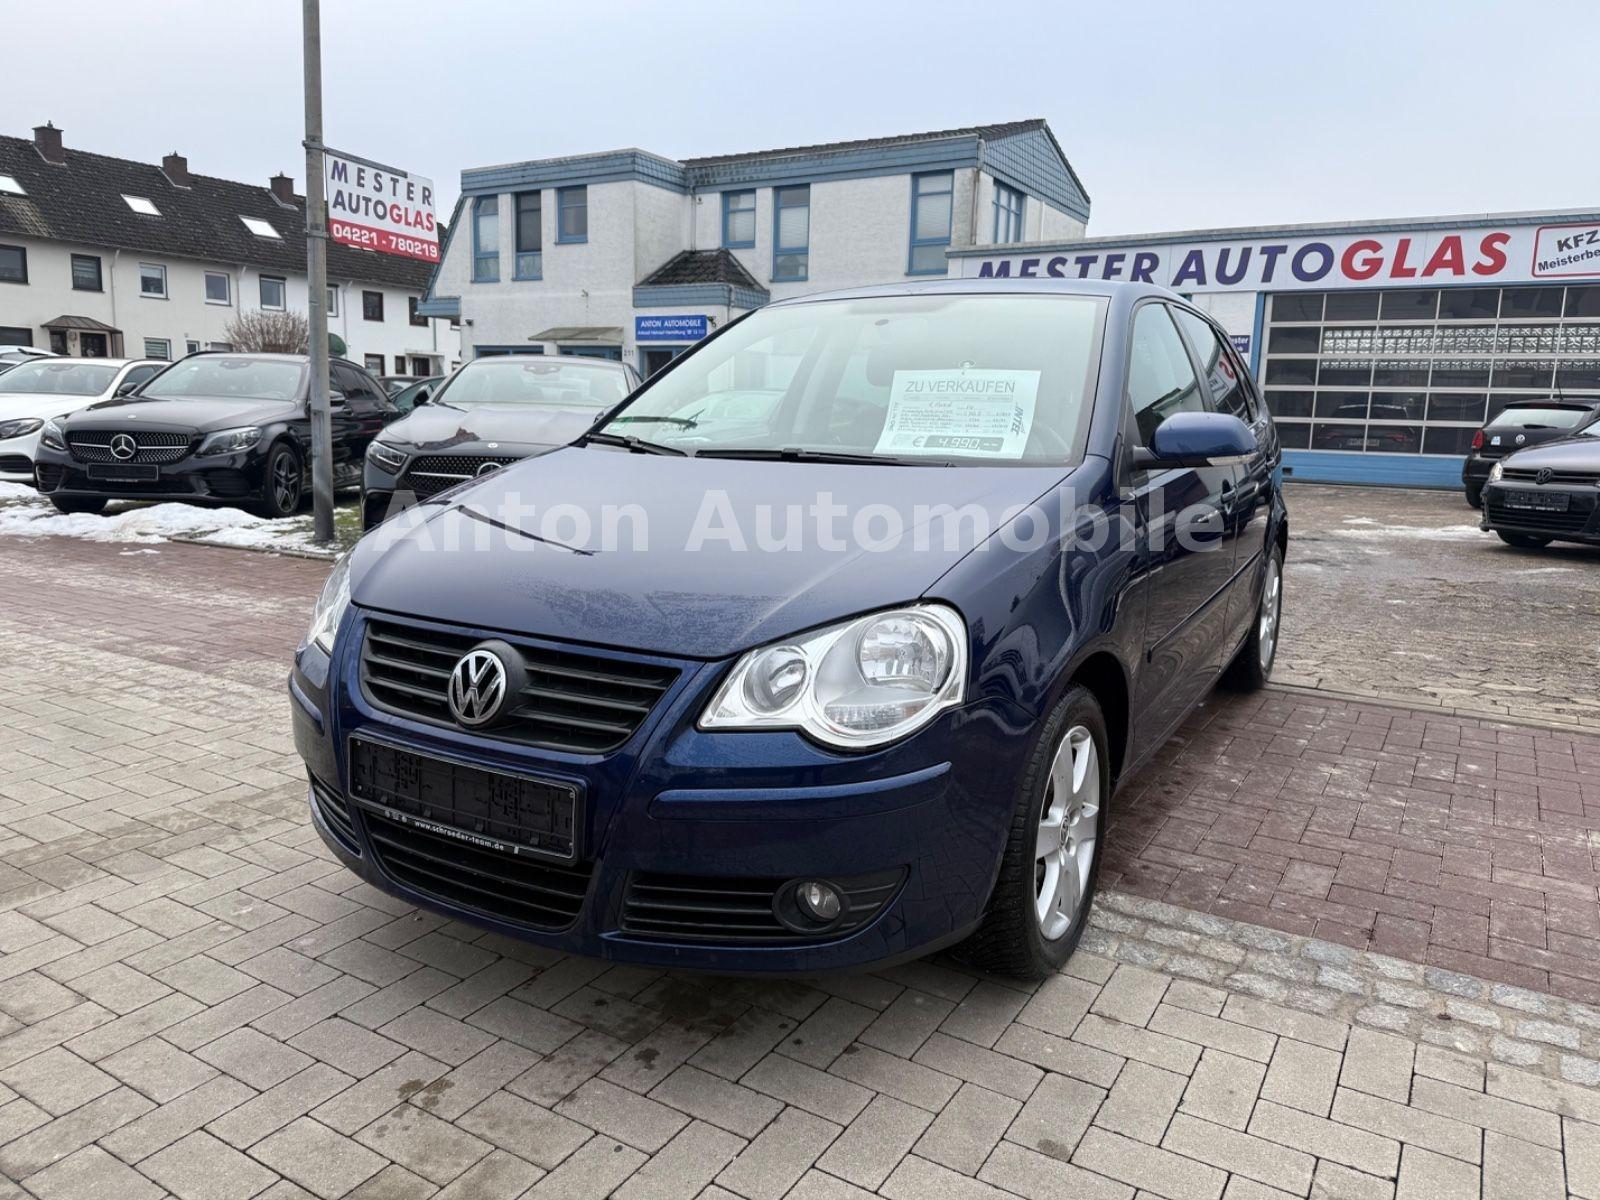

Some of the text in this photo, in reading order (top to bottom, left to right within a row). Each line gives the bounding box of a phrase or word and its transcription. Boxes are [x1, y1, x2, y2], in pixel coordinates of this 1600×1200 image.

[331, 159, 432, 206] MESTER
[332, 189, 435, 232] AUTOGLAS
[1556, 229, 1600, 252] KFZ
[1170, 232, 1512, 287] AUTOGLAS
[641, 319, 701, 328] ANTON AUTOMOBILE
[905, 380, 1016, 393] ZU VERKAUFEN
